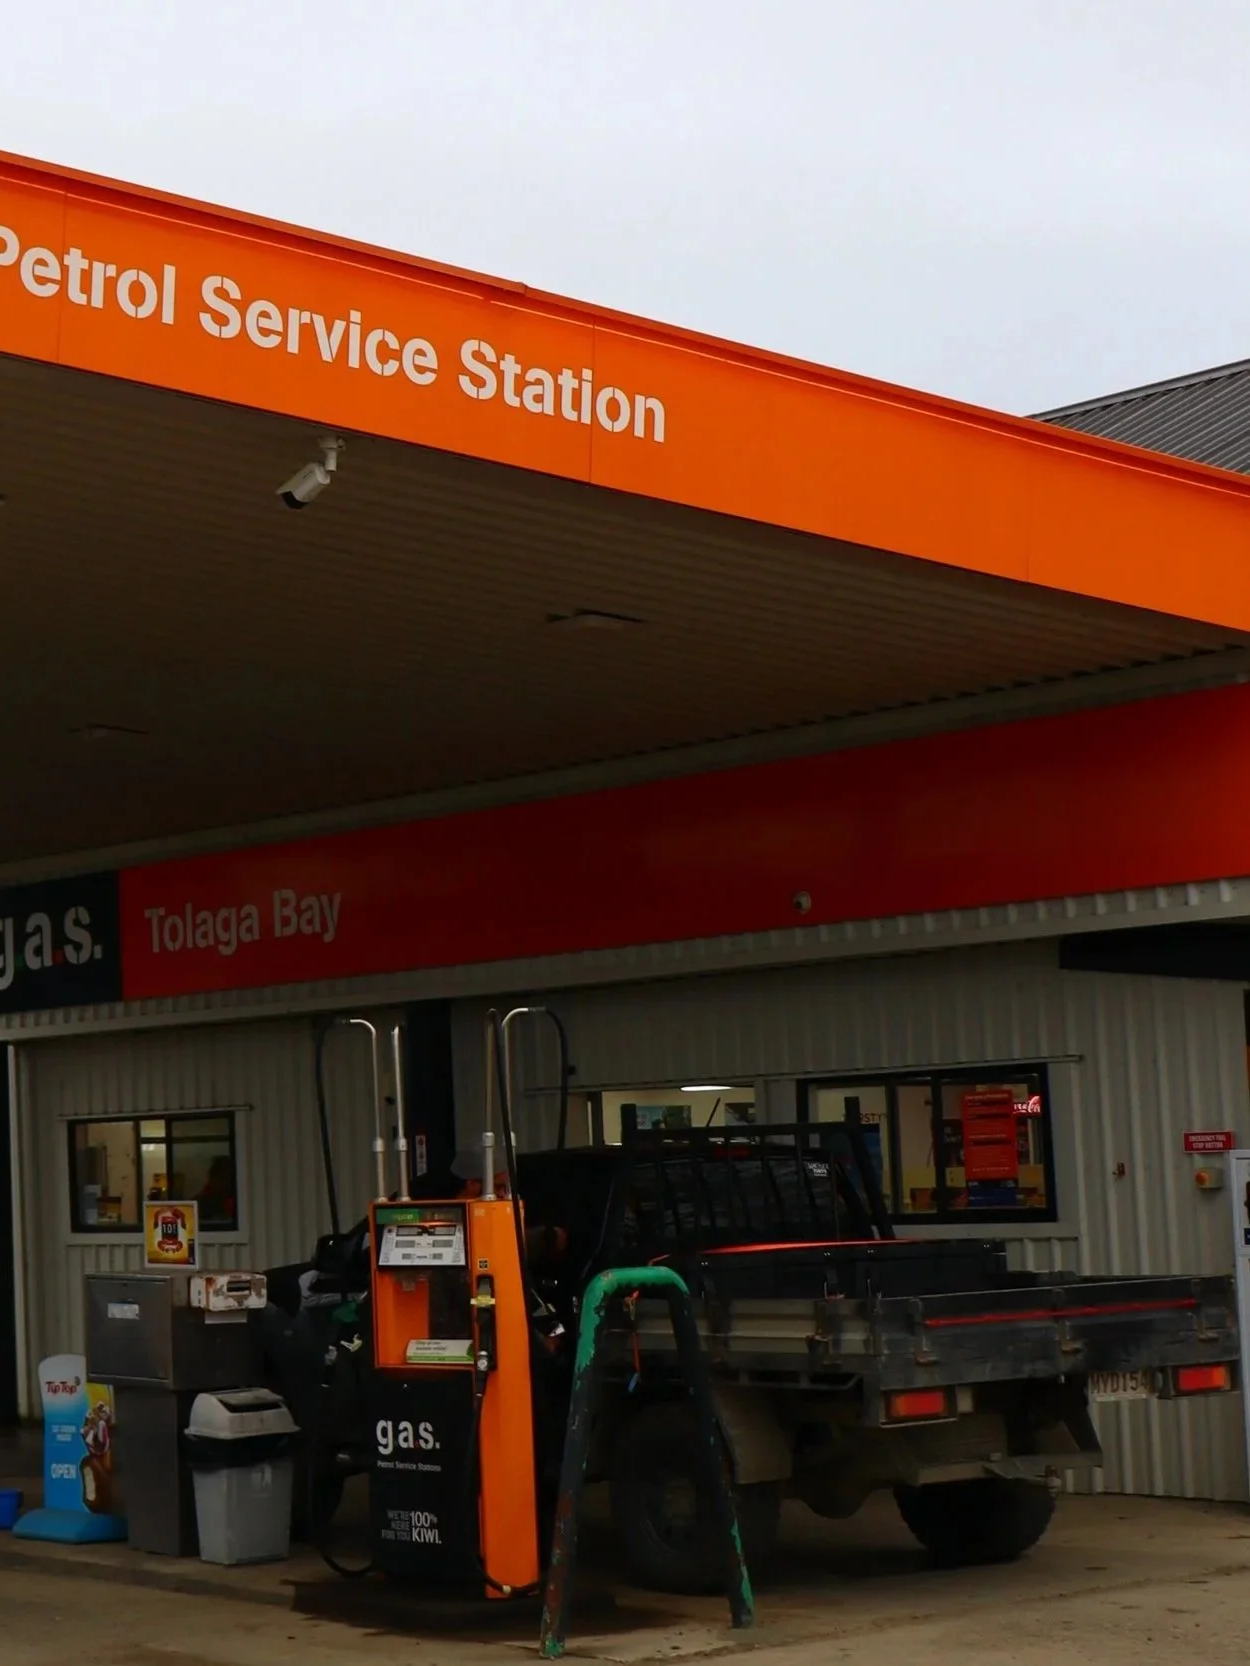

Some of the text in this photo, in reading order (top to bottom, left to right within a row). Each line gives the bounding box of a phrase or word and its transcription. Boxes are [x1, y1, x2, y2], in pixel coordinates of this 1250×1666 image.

[198, 275, 438, 386] Service
[458, 339, 666, 443] Station
[144, 888, 342, 957] Tolaga Bay
[51, 1463, 77, 1480] OPEN
[395, 1460, 416, 1470] Service
